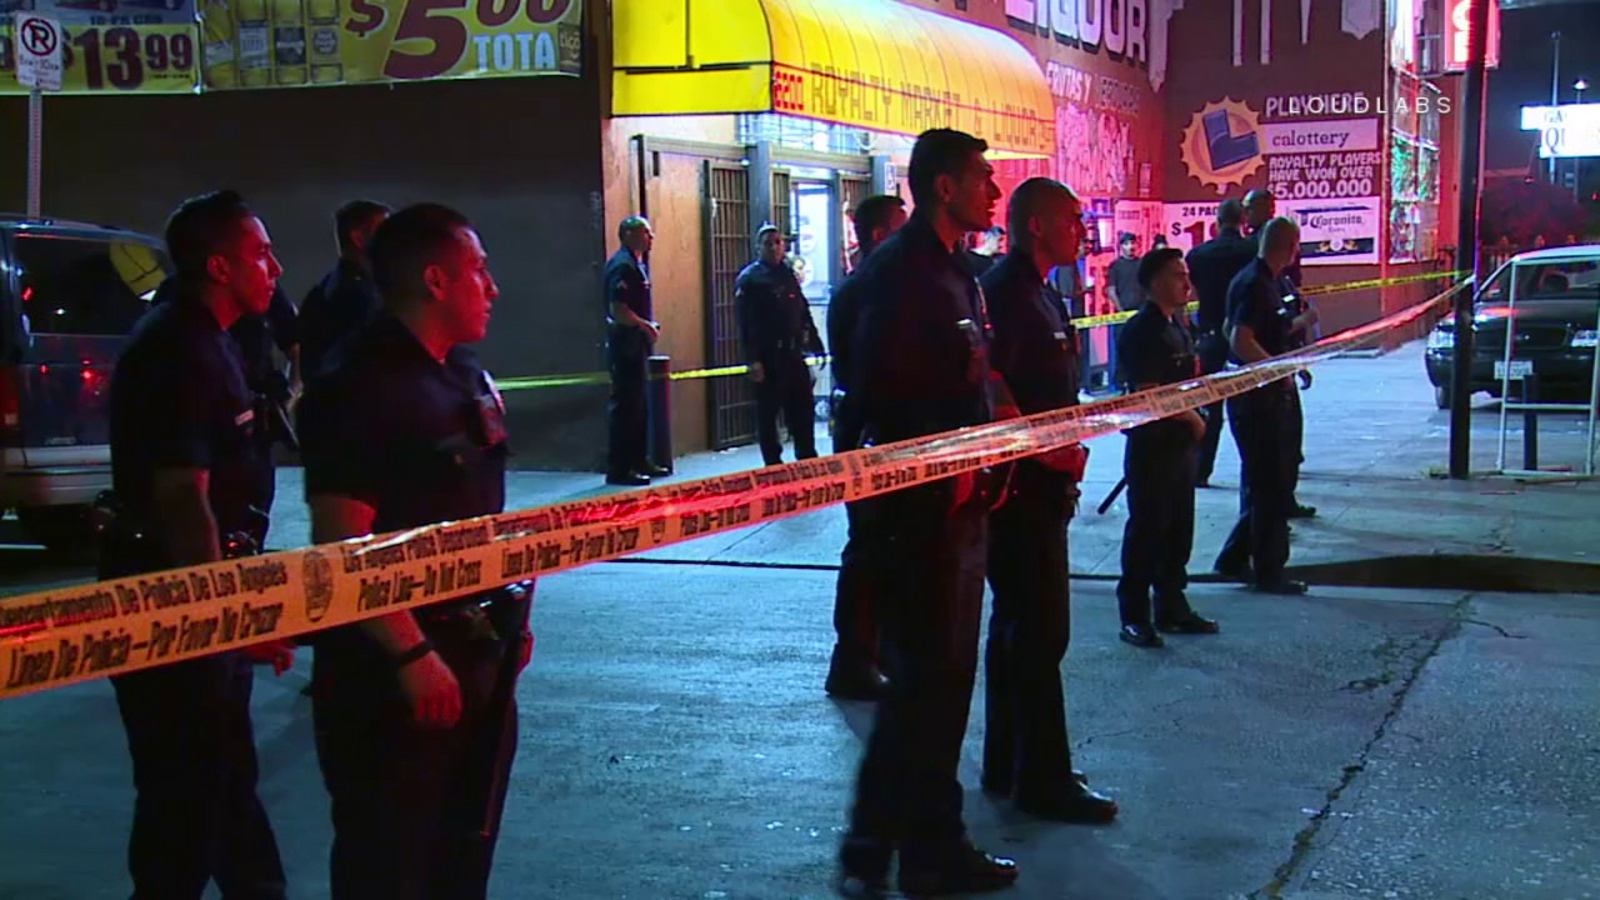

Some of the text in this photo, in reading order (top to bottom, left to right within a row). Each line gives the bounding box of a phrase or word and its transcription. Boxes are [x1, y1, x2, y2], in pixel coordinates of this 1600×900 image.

[810, 62, 892, 124] ROYALTY
[1271, 129, 1350, 148] calottery
[1269, 151, 1382, 169] ROYALTY PLAYERS
[1269, 166, 1373, 181] HAVE WON OVER
